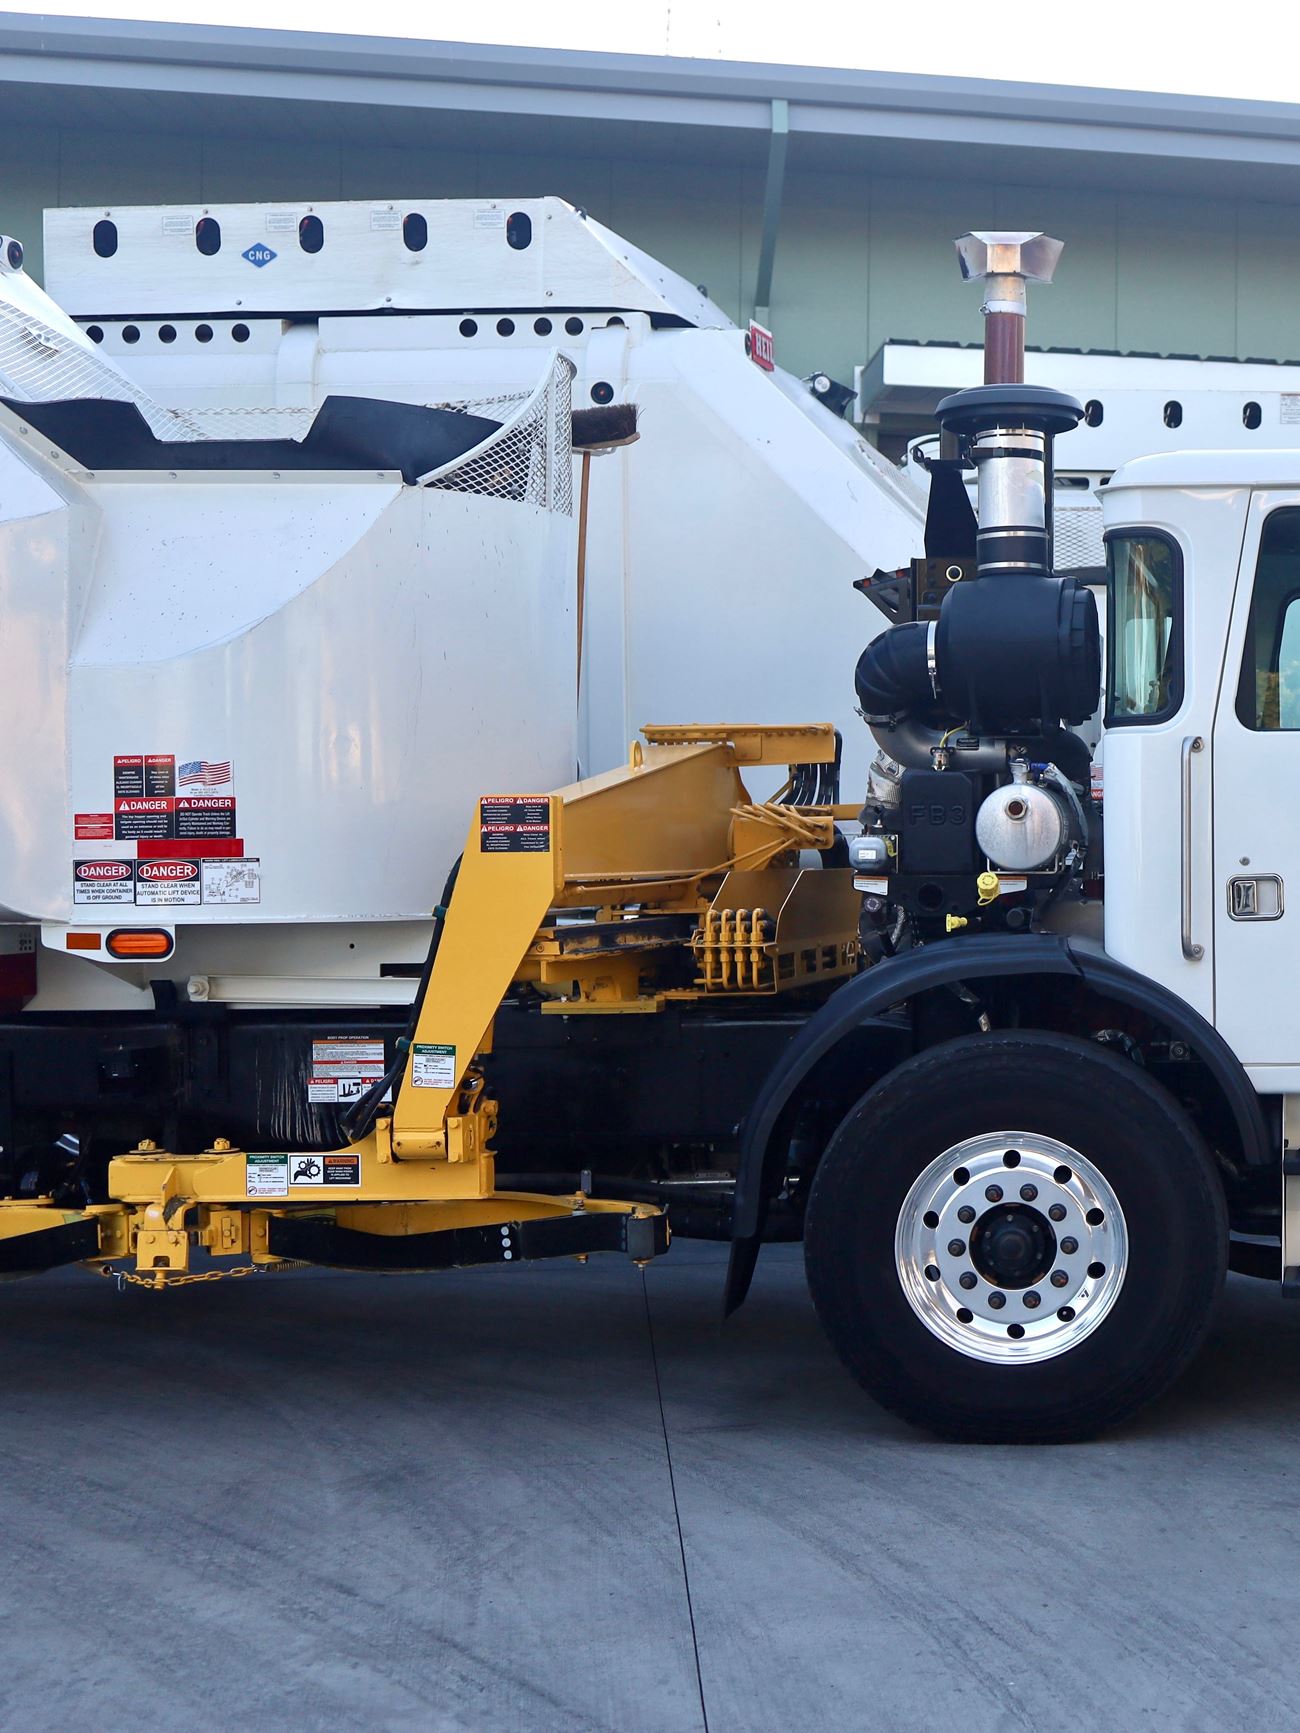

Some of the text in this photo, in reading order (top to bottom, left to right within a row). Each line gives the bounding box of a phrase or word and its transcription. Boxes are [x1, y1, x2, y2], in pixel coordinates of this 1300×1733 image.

[249, 251, 270, 260] CNG
[131, 800, 167, 810] DANGER
[191, 799, 231, 807] DANGER
[81, 866, 126, 876] DANGER
[143, 865, 192, 876] DANGER
